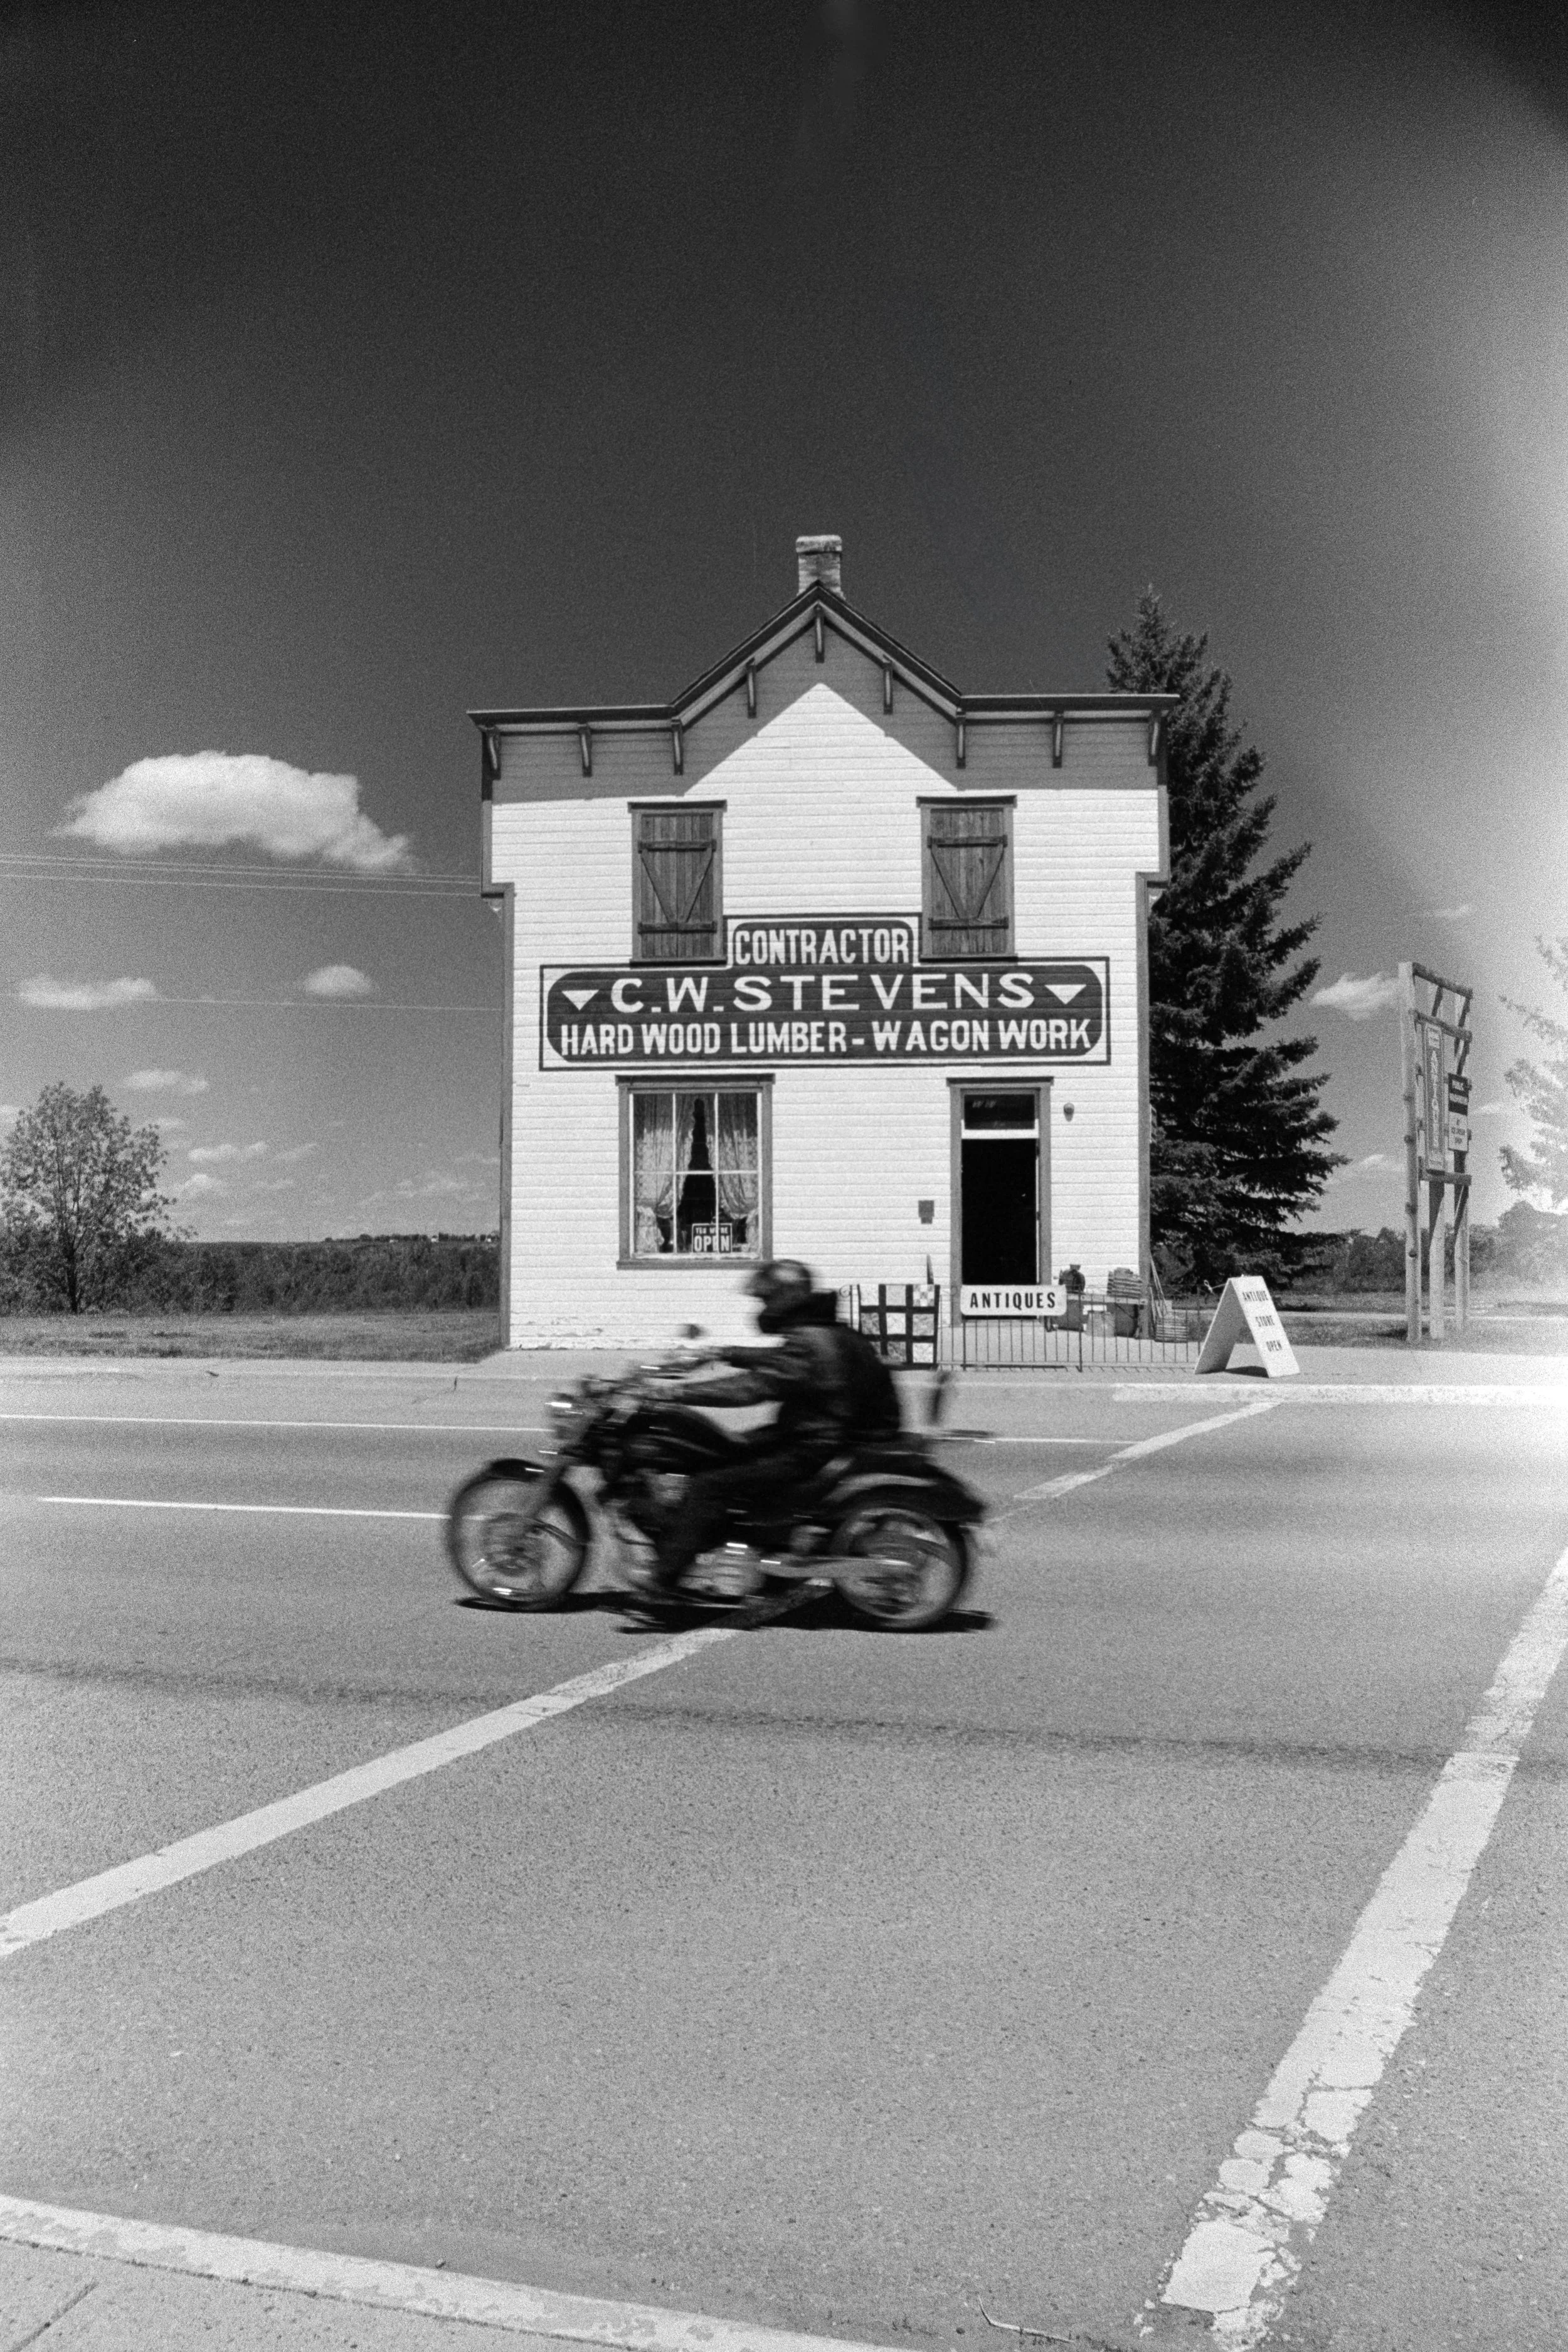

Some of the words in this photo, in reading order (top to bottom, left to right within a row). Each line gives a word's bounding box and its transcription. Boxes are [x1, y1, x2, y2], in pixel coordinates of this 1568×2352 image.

[734, 928, 909, 965] CONTRACTOR
[733, 973, 1036, 1012] STEVENS
[561, 1023, 635, 1056] HARD
[641, 1022, 721, 1055] WOOD
[997, 1019, 1092, 1051] WORK
[694, 1235, 730, 1253] OPEN
[970, 1291, 1056, 1311] ANTIQUES
[1255, 1315, 1275, 1327] STORE
[1266, 1339, 1283, 1352] OPEN
